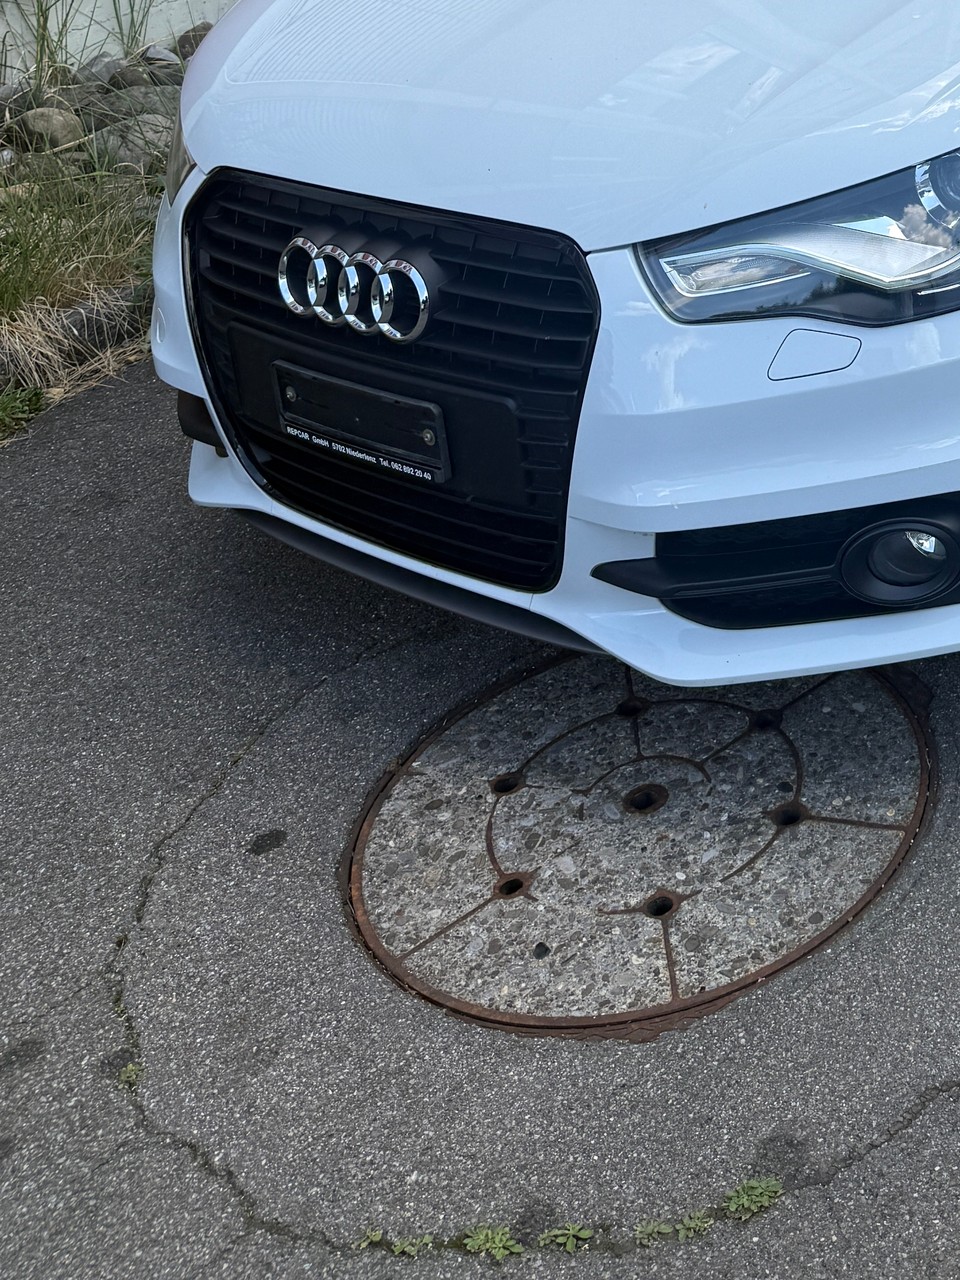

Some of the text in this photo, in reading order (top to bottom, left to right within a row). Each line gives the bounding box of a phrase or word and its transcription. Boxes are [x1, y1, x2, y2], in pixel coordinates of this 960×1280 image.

[287, 426, 310, 440] REPCAR
[312, 435, 329, 447] GmbH
[332, 442, 346, 453] 5702
[346, 447, 377, 463] Niederlenz
[379, 457, 391, 468] Tel.
[415, 469, 423, 477] 20
[423, 472, 432, 480] 40
